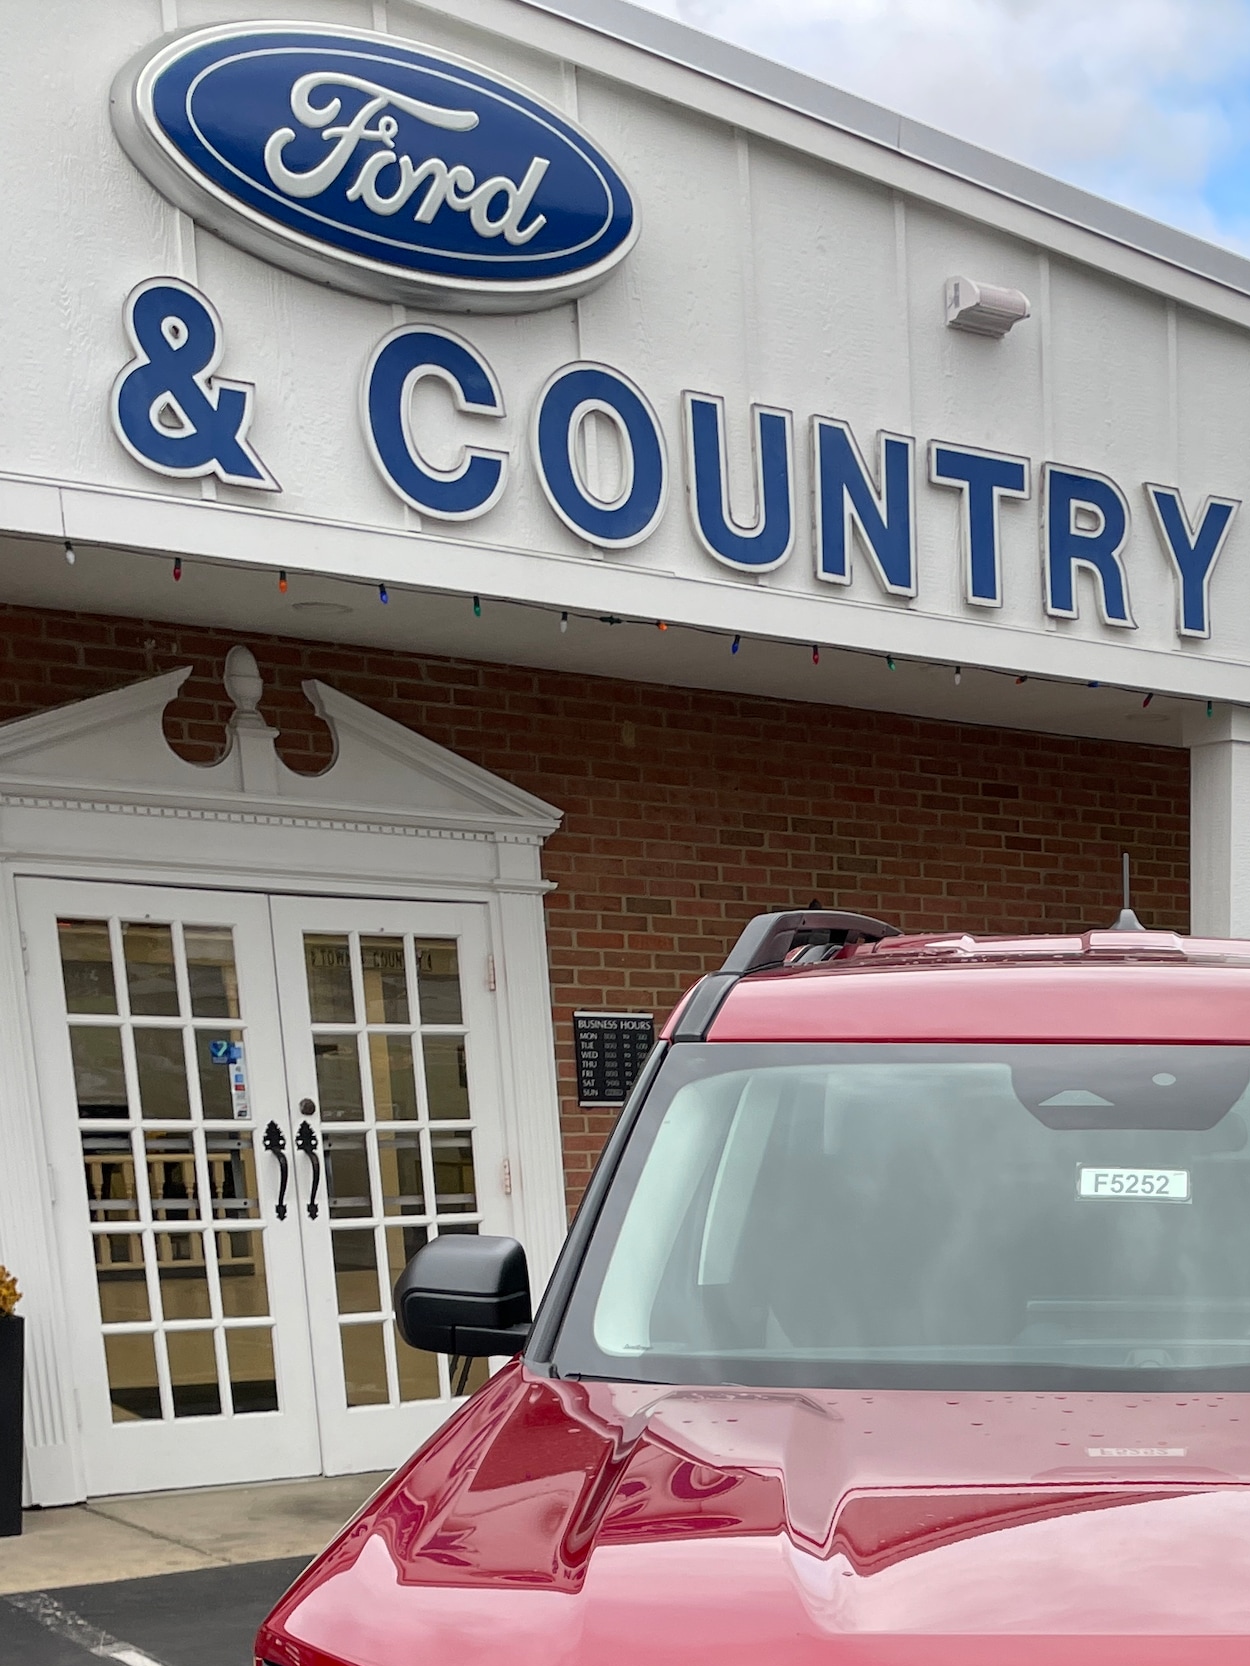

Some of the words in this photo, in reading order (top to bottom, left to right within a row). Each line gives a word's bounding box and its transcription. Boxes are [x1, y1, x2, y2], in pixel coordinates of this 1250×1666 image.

[265, 71, 550, 244] Ford
[112, 276, 282, 493] &
[358, 323, 1242, 640] COUNTRY
[578, 1020, 618, 1029] BUSINESS
[620, 1021, 651, 1030] HOURS
[579, 1032, 598, 1040] MON
[581, 1051, 599, 1059] WED
[582, 1079, 596, 1087] SAT
[1094, 1173, 1170, 1194] F5252
